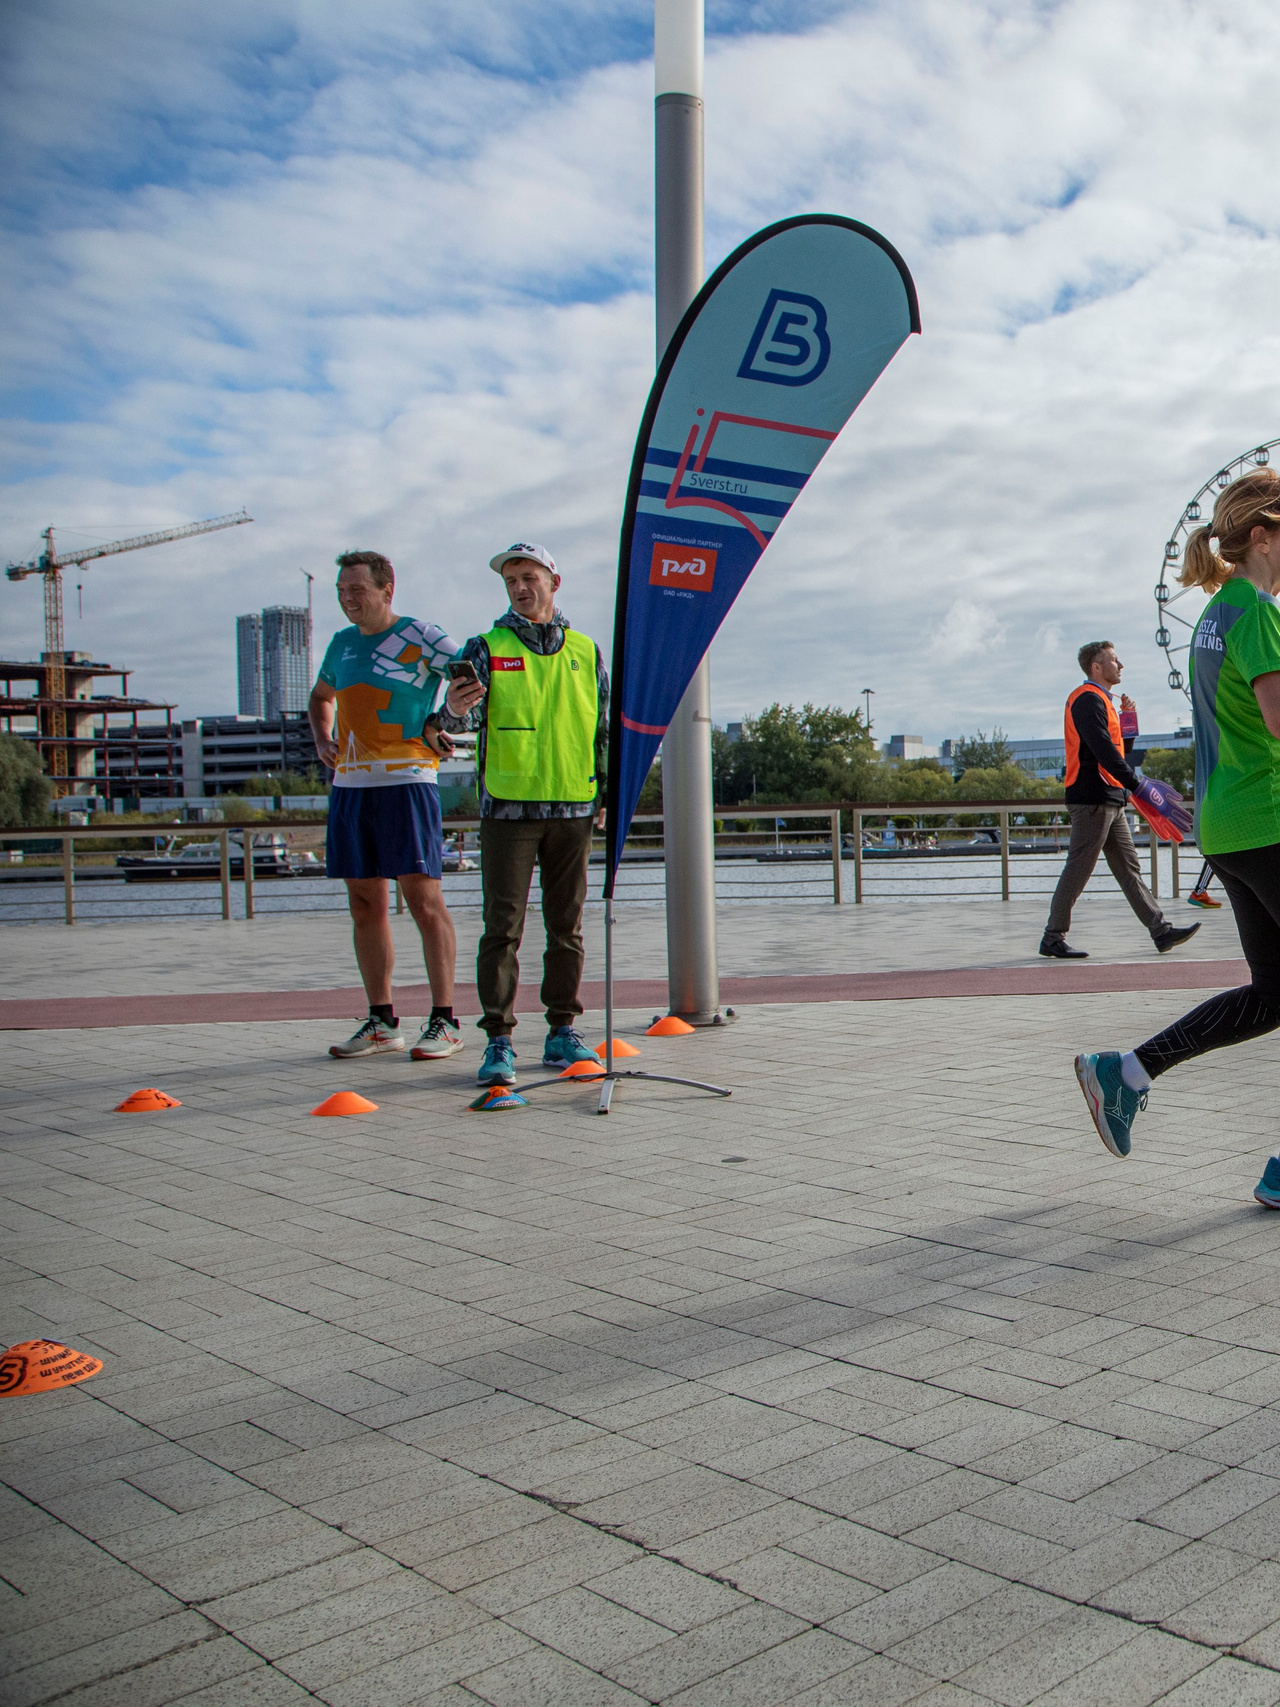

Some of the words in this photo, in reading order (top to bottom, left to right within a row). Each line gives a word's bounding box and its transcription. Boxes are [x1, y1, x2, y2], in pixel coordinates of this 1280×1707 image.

[689, 473, 748, 495] 5verst.ru
[652, 533, 697, 545] ОФИЦИАЛЬНЫЙ
[696, 540, 723, 549] ПАРТНЕР
